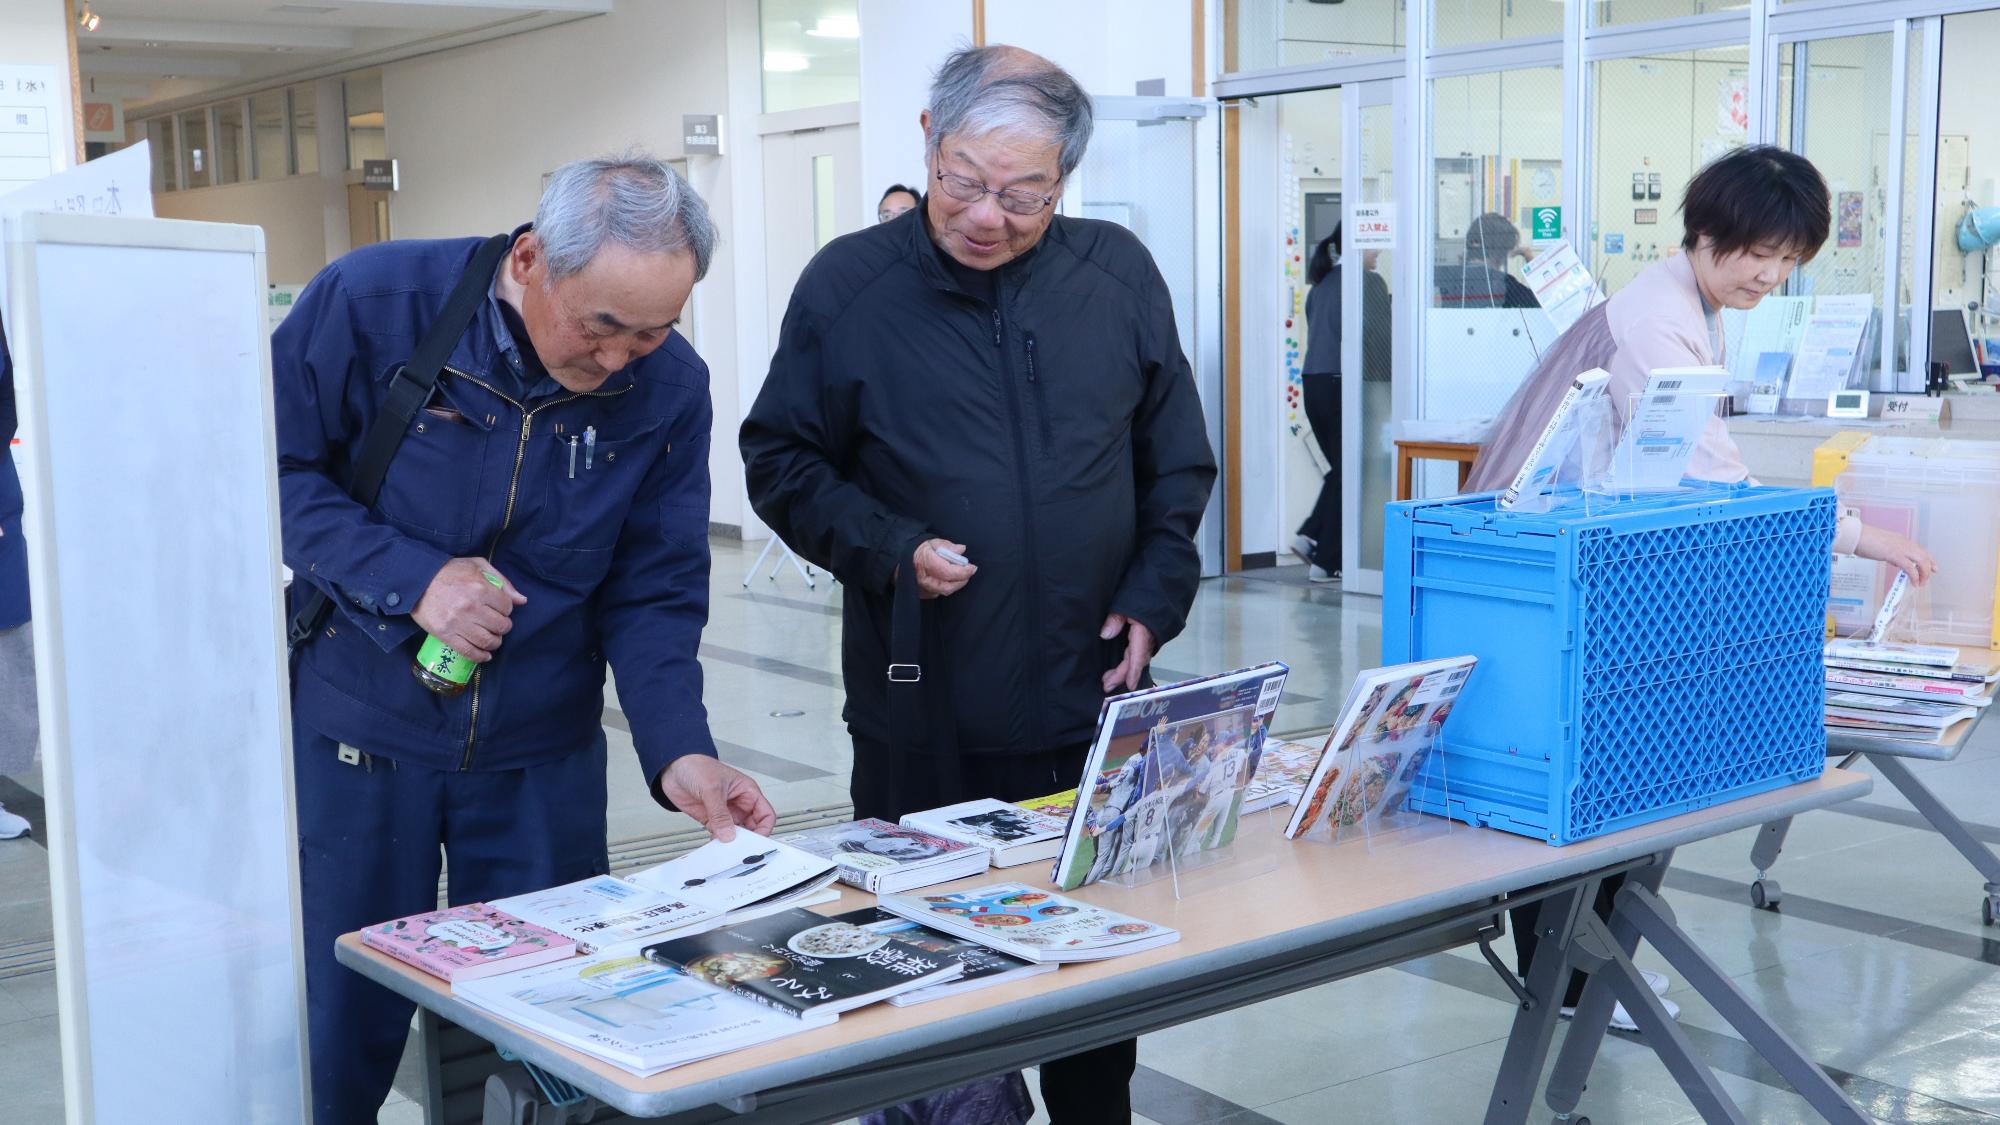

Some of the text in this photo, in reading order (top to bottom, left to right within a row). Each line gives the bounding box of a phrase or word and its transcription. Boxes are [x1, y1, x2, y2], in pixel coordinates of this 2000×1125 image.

[1359, 223, 1390, 232] 立入禁止
[1886, 400, 1909, 412] 受付
[1223, 760, 1236, 780] 13
[1145, 807, 1155, 826] 8
[857, 946, 939, 976] 雑穀
[770, 977, 833, 1000] みそ
